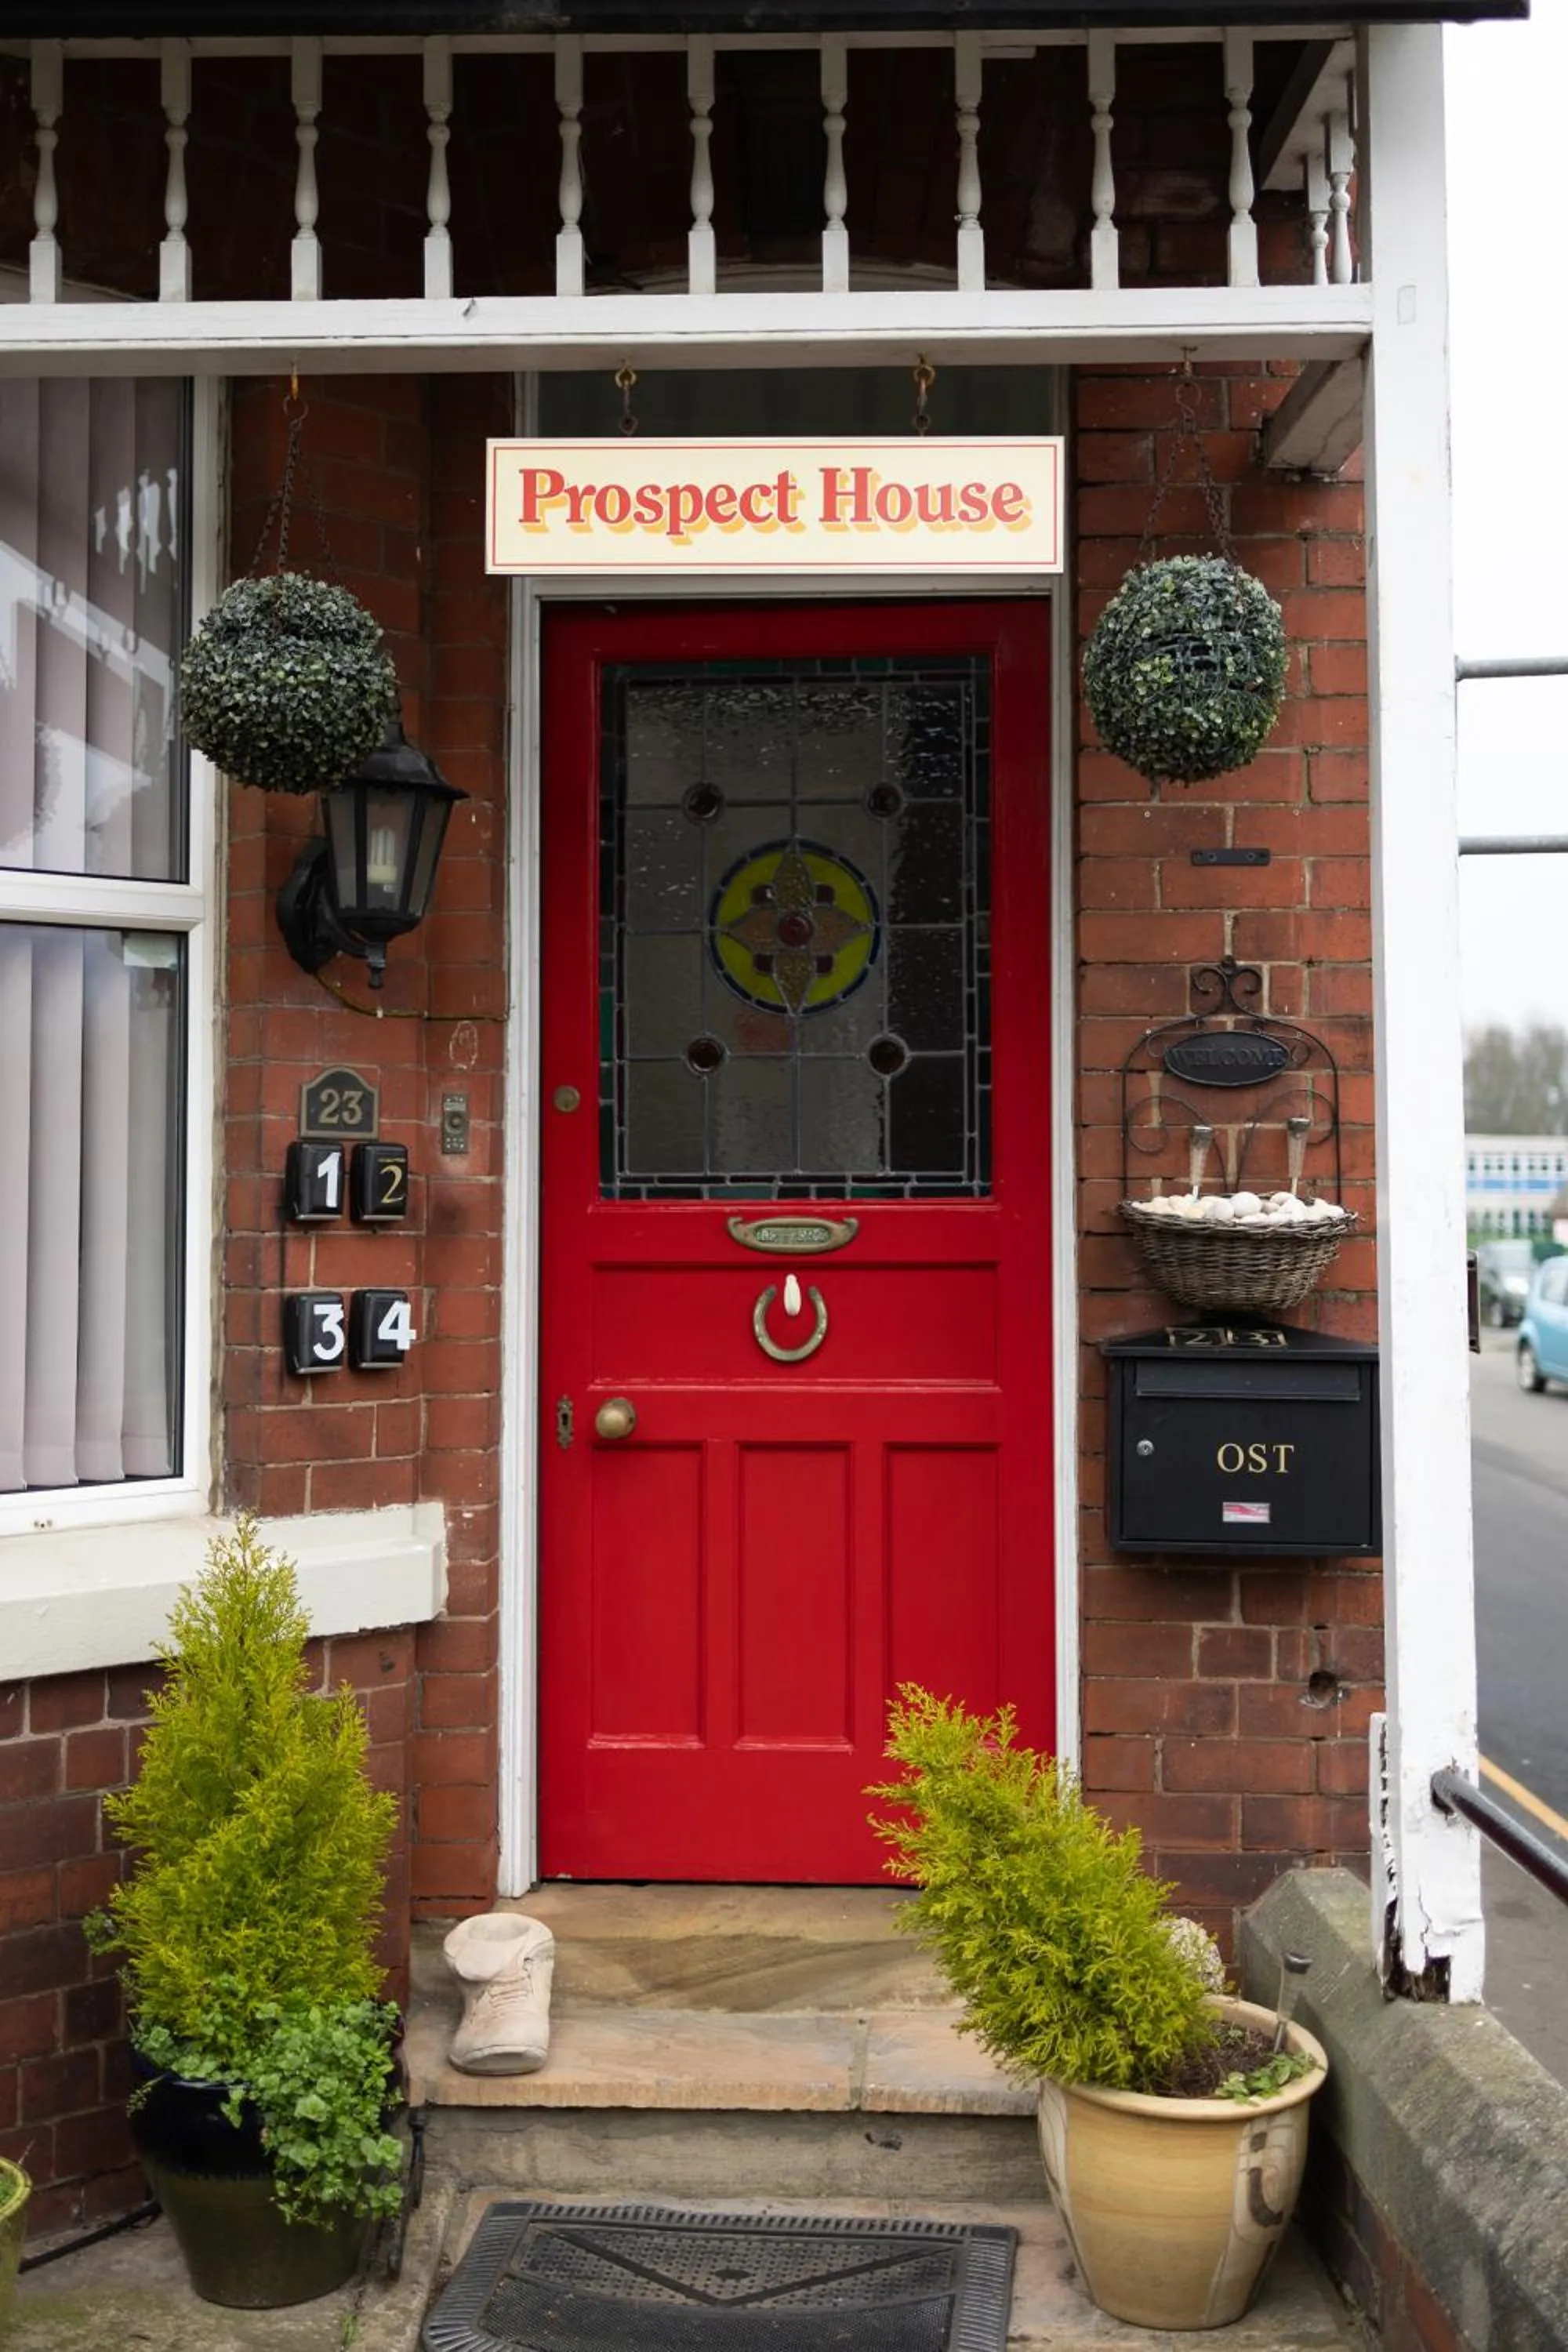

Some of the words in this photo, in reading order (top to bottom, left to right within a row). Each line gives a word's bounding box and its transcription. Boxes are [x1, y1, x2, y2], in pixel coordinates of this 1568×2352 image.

[517, 468, 803, 542] Prospect
[818, 466, 1030, 530] House
[318, 1088, 364, 1125] 23
[318, 1151, 342, 1208] 1
[379, 1163, 405, 1204] 2
[313, 1303, 345, 1361] 3
[377, 1300, 416, 1351] 4
[1217, 1443, 1294, 1473] OST
